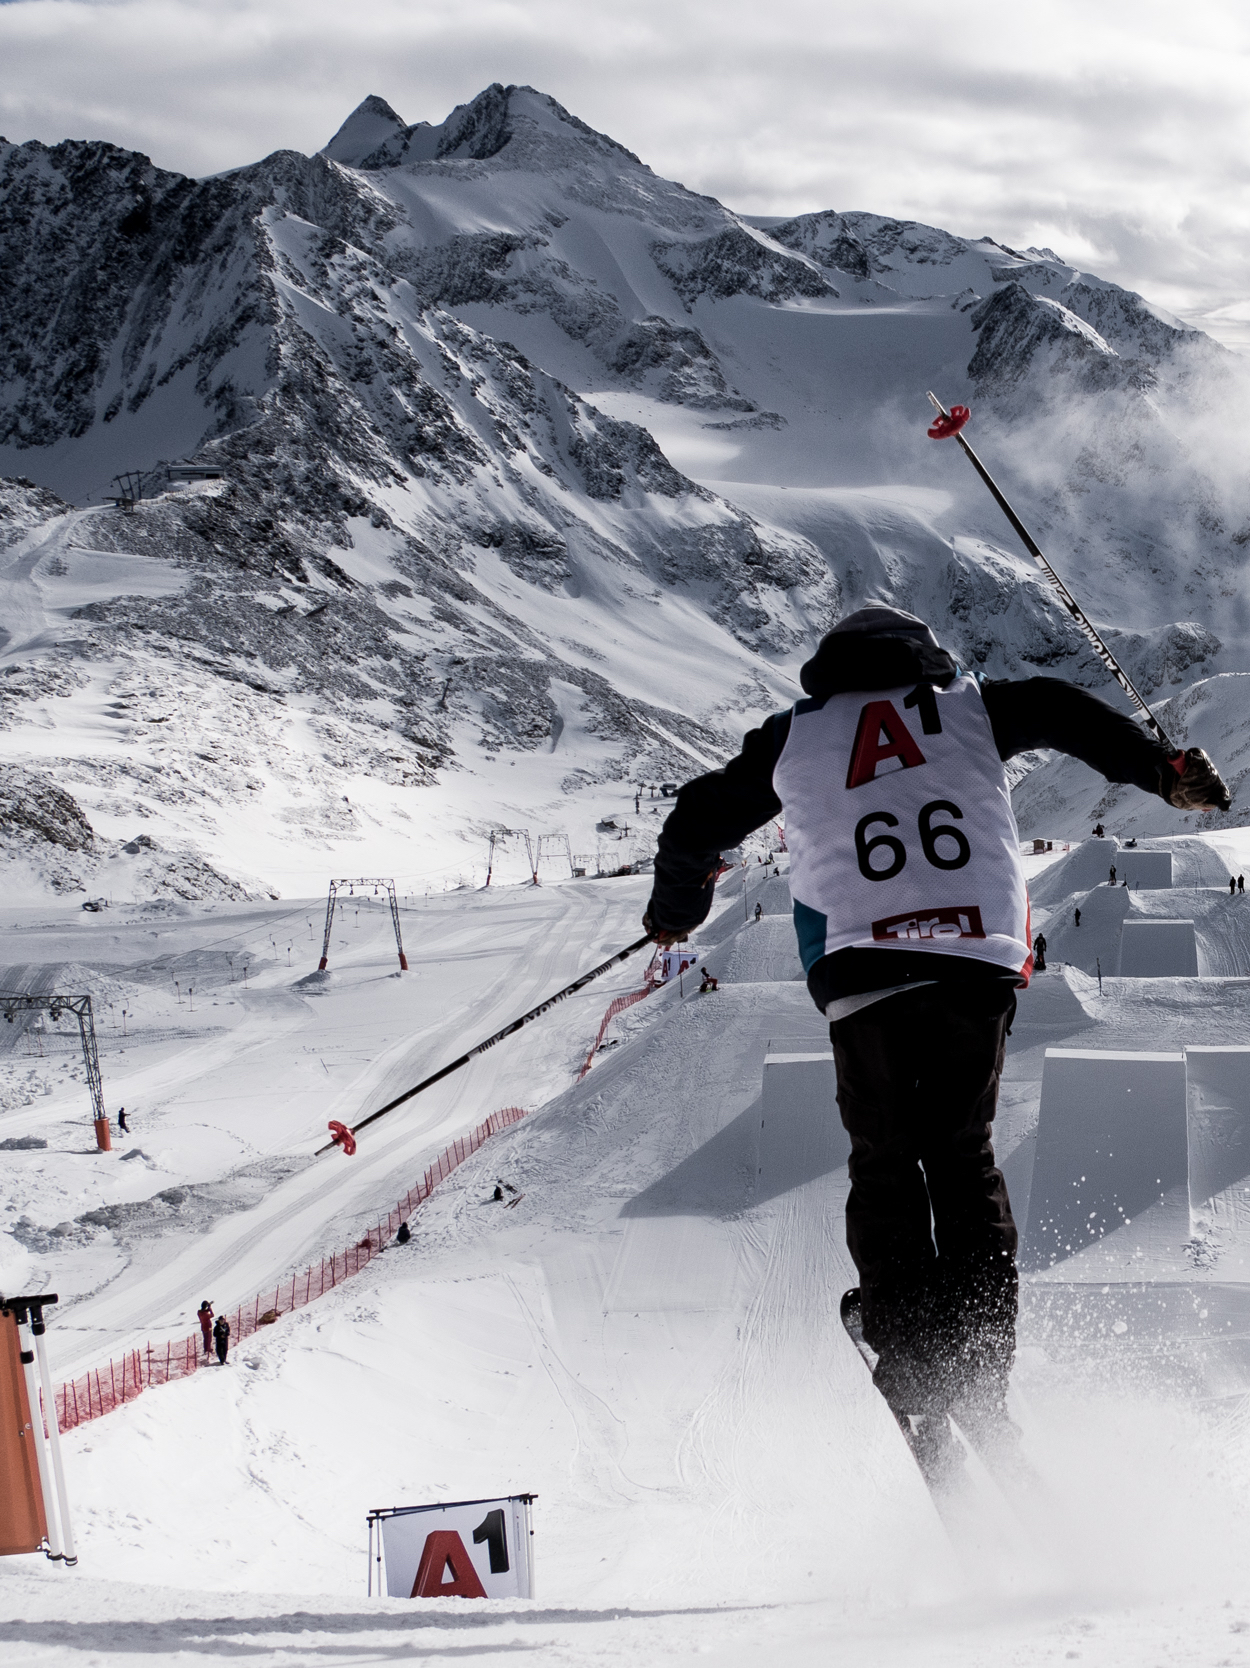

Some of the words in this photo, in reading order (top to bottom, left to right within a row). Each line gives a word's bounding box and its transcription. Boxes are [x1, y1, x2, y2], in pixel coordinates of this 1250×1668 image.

[1073, 612, 1118, 671] ATOMIC
[846, 684, 942, 790] A1
[854, 800, 971, 882] 66
[886, 913, 972, 939] Tirol
[661, 957, 671, 977] A1
[523, 987, 575, 1024] ATOMIC
[410, 1508, 510, 1599] A1
